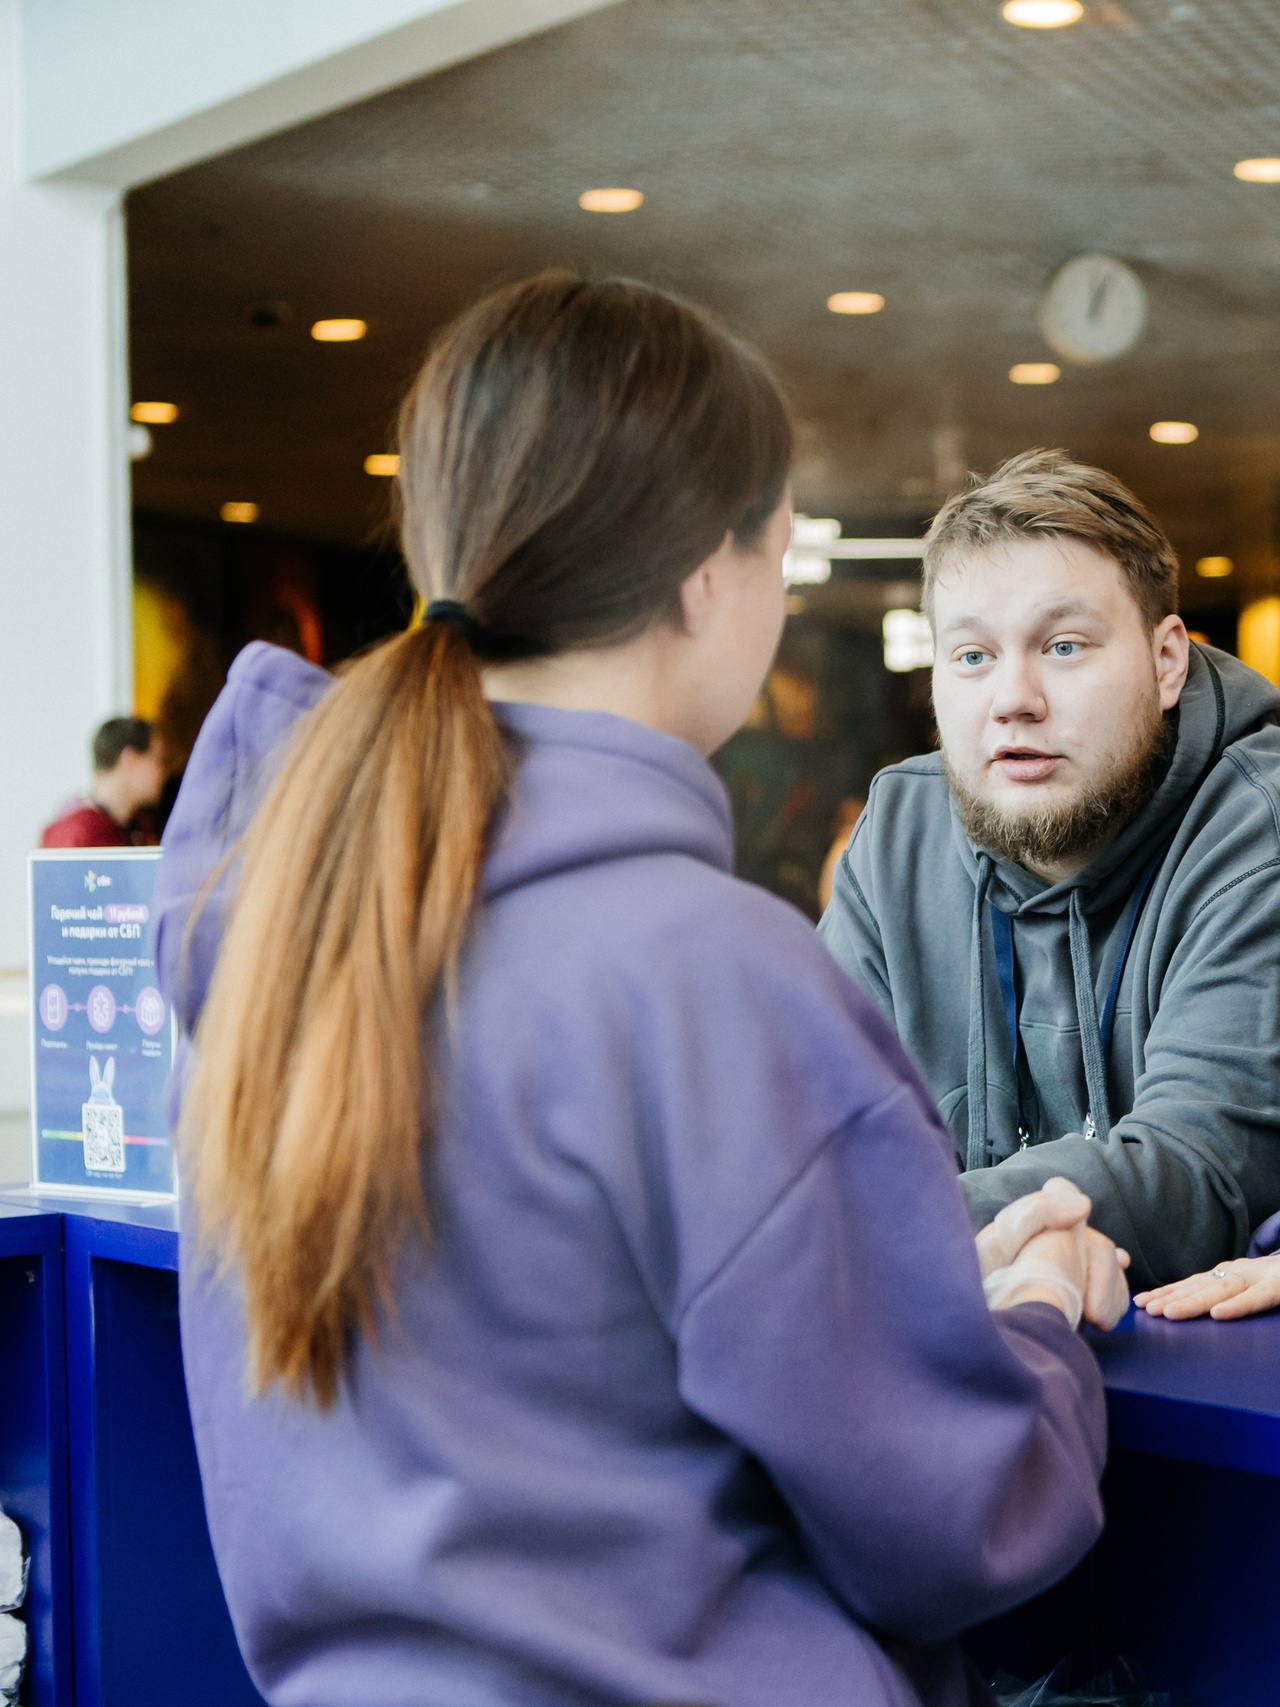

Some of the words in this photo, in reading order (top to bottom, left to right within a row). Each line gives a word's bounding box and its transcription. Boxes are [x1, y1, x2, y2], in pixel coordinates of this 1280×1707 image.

[51, 904, 86, 923] Горячий
[87, 905, 103, 920] чай
[69, 926, 107, 941] подарки
[107, 926, 119, 938] от
[119, 923, 141, 939] СБП
